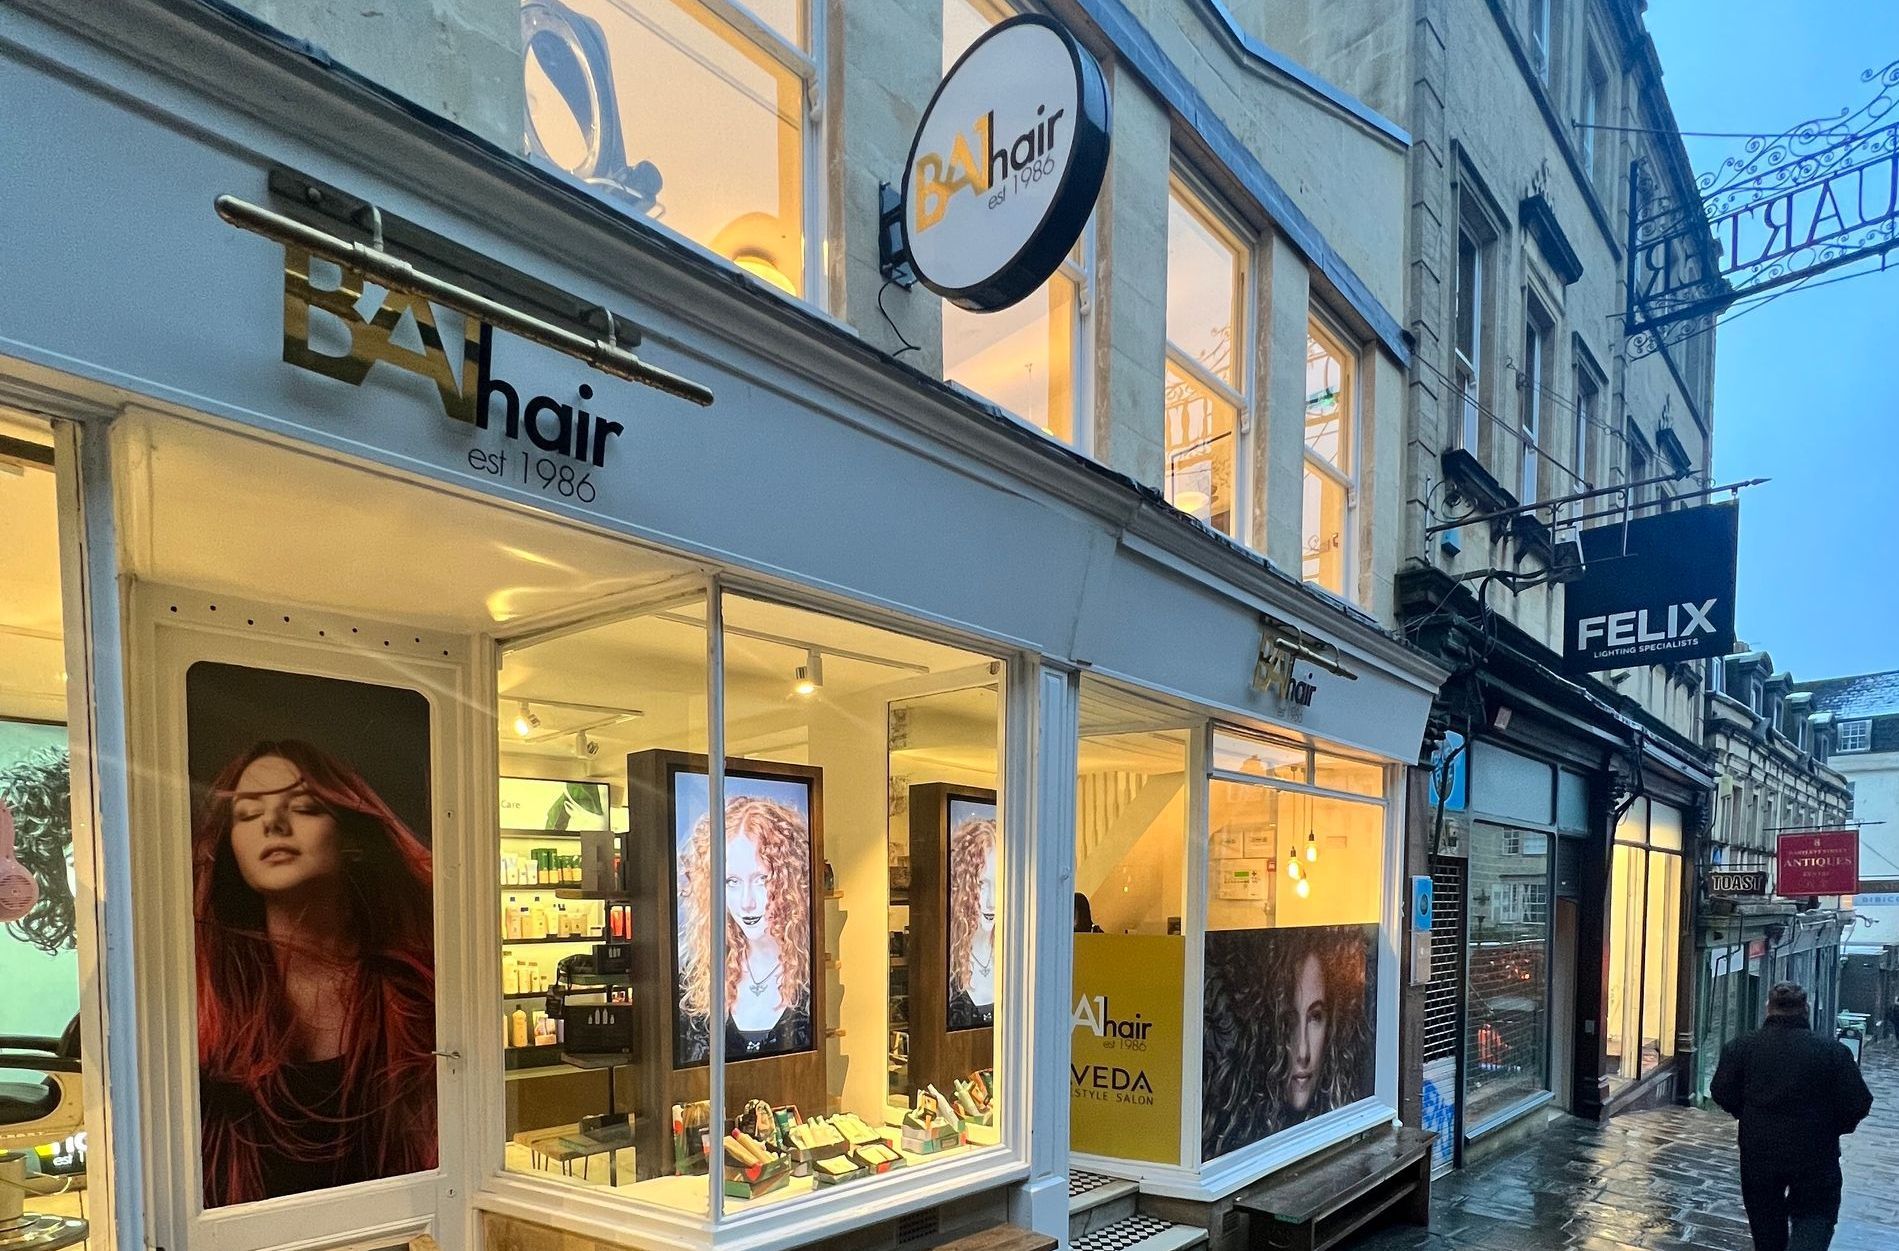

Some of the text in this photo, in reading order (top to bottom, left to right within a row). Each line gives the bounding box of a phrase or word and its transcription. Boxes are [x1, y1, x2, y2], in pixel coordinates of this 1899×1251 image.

[988, 156, 1055, 209] est 1986
[468, 448, 596, 503] est 1986
[1577, 598, 1718, 651] FELIX
[1593, 638, 1699, 659] LIGHTING SPECIALISTS
[500, 799, 521, 809] Care
[1783, 857, 1852, 867] ANTIQUES
[1711, 875, 1763, 890] TOAST
[1071, 993, 1153, 1040] A1hair
[1103, 1040, 1147, 1052] est 1986
[1070, 1063, 1153, 1093] VEDA
[1072, 1088, 1154, 1105] STYLE SALON
